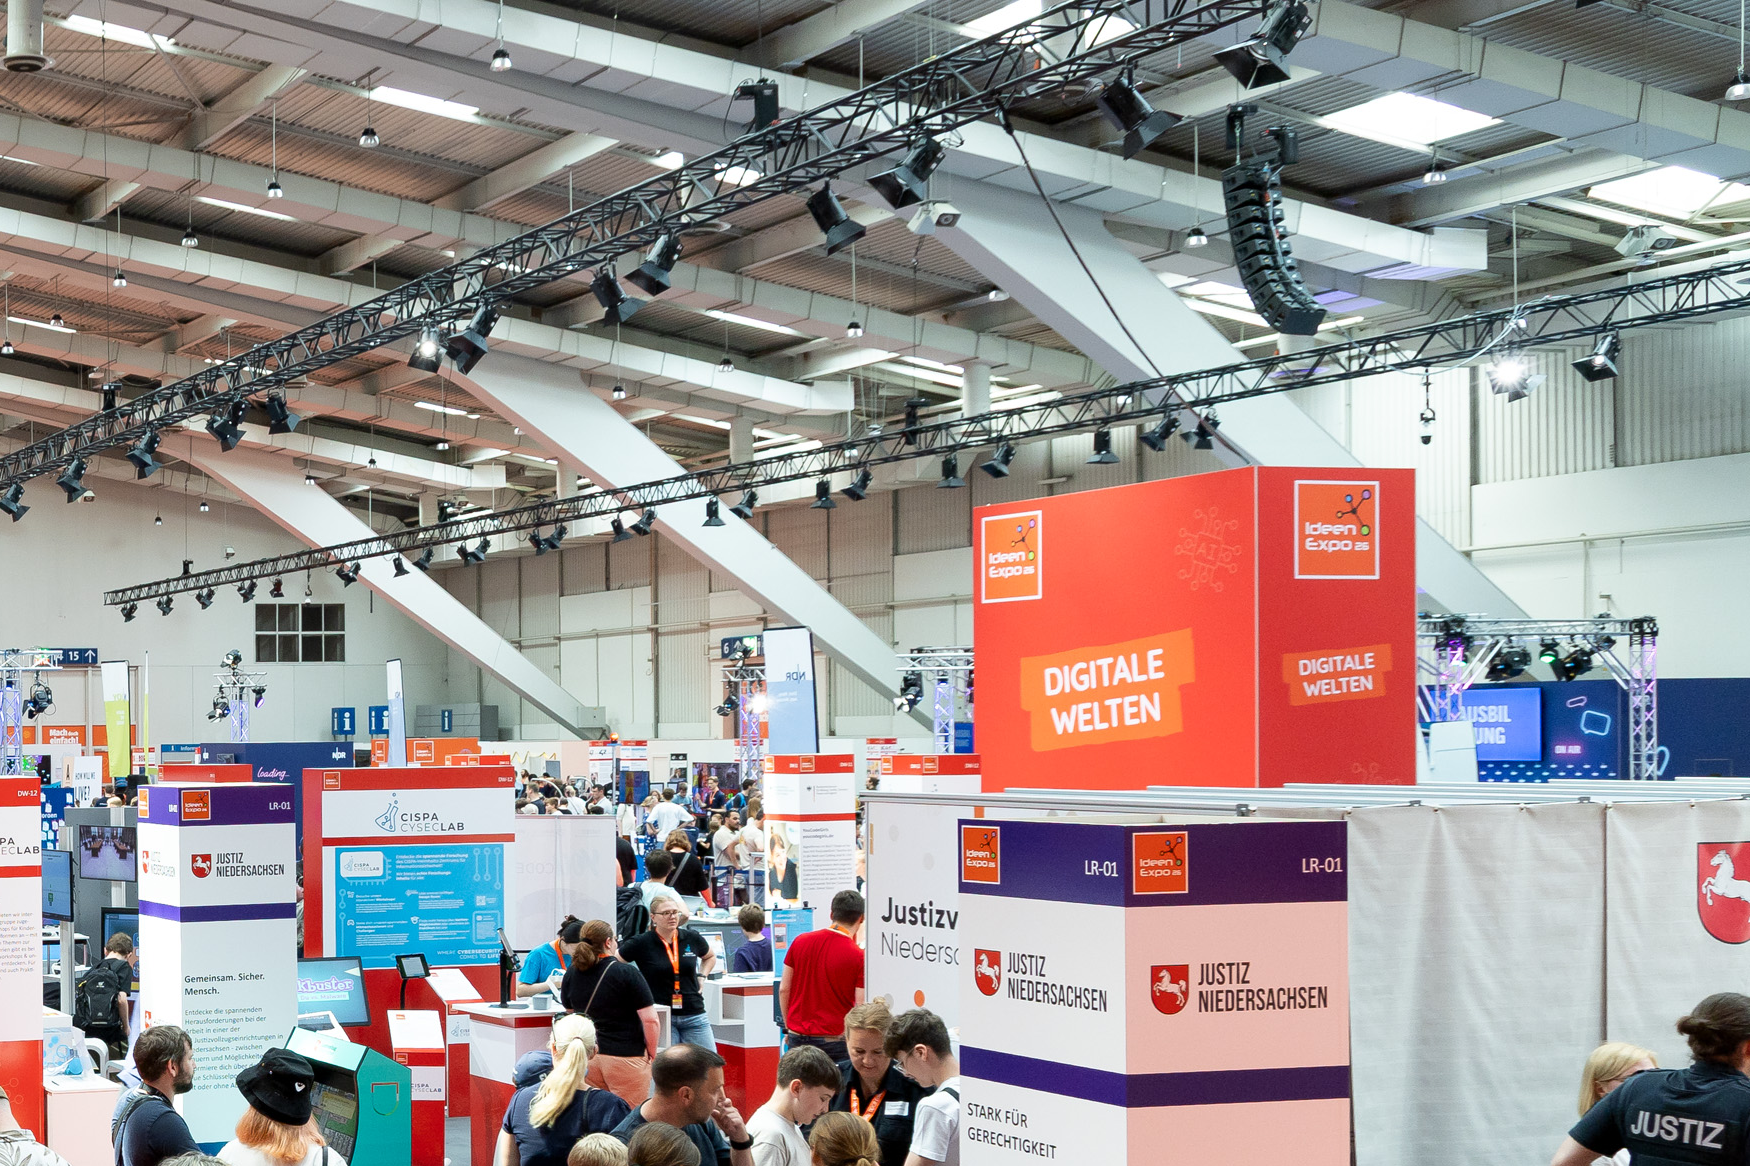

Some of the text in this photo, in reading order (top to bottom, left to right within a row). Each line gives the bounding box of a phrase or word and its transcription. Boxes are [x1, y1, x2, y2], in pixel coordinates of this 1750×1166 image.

[1305, 522, 1357, 536] Ideen
[1305, 538, 1370, 553] Expo 26
[989, 550, 1025, 564] Ideen
[989, 565, 1022, 579] Expo
[723, 644, 729, 653] 6
[69, 652, 79, 660] 15
[1298, 652, 1375, 677] DIGITALE
[1044, 648, 1165, 696] DIGITALE
[1303, 675, 1374, 697] WELTEN
[1050, 692, 1161, 735] WELTEN
[1459, 705, 1512, 724] AUSBIL
[50, 736, 79, 744] einfach!
[1474, 727, 1506, 745] UNG
[1555, 745, 1581, 754] ON AIR
[269, 802, 291, 811] LR-01
[401, 813, 439, 821] CISPA
[401, 822, 465, 832] CYSECLAB
[216, 852, 244, 865] JUSTIZ
[966, 848, 990, 860] Ideen
[966, 858, 987, 868] Expo
[1085, 859, 1119, 877] LR-01
[1139, 858, 1173, 868] Ideen
[1301, 857, 1343, 873] LR-01
[216, 864, 284, 878] NIEDERSACHSEN
[1139, 867, 1170, 878] Expo
[881, 896, 958, 931] Justizv
[1007, 951, 1046, 978] JUSTIZ
[185, 973, 265, 984] Gemeinsam. Sicher.
[1198, 961, 1250, 986] JUSTIZ
[298, 977, 353, 991] kbuster
[185, 987, 220, 996] Mensch.
[1007, 981, 1107, 1013] NIEDERSACHSEN
[1198, 986, 1328, 1013] NIEDERSACHSEN
[185, 1008, 212, 1016] Entdecke
[225, 1006, 262, 1015] spannenden
[185, 1017, 243, 1026] Herausforderungen
[256, 1015, 266, 1023] der
[194, 1034, 276, 1044] Justizvollzugseinrichtungen
[967, 1102, 1028, 1128] STARK FÜR
[1631, 1110, 1725, 1150] JUSTIZ
[967, 1126, 1057, 1159] GERECHTIGKEIT
